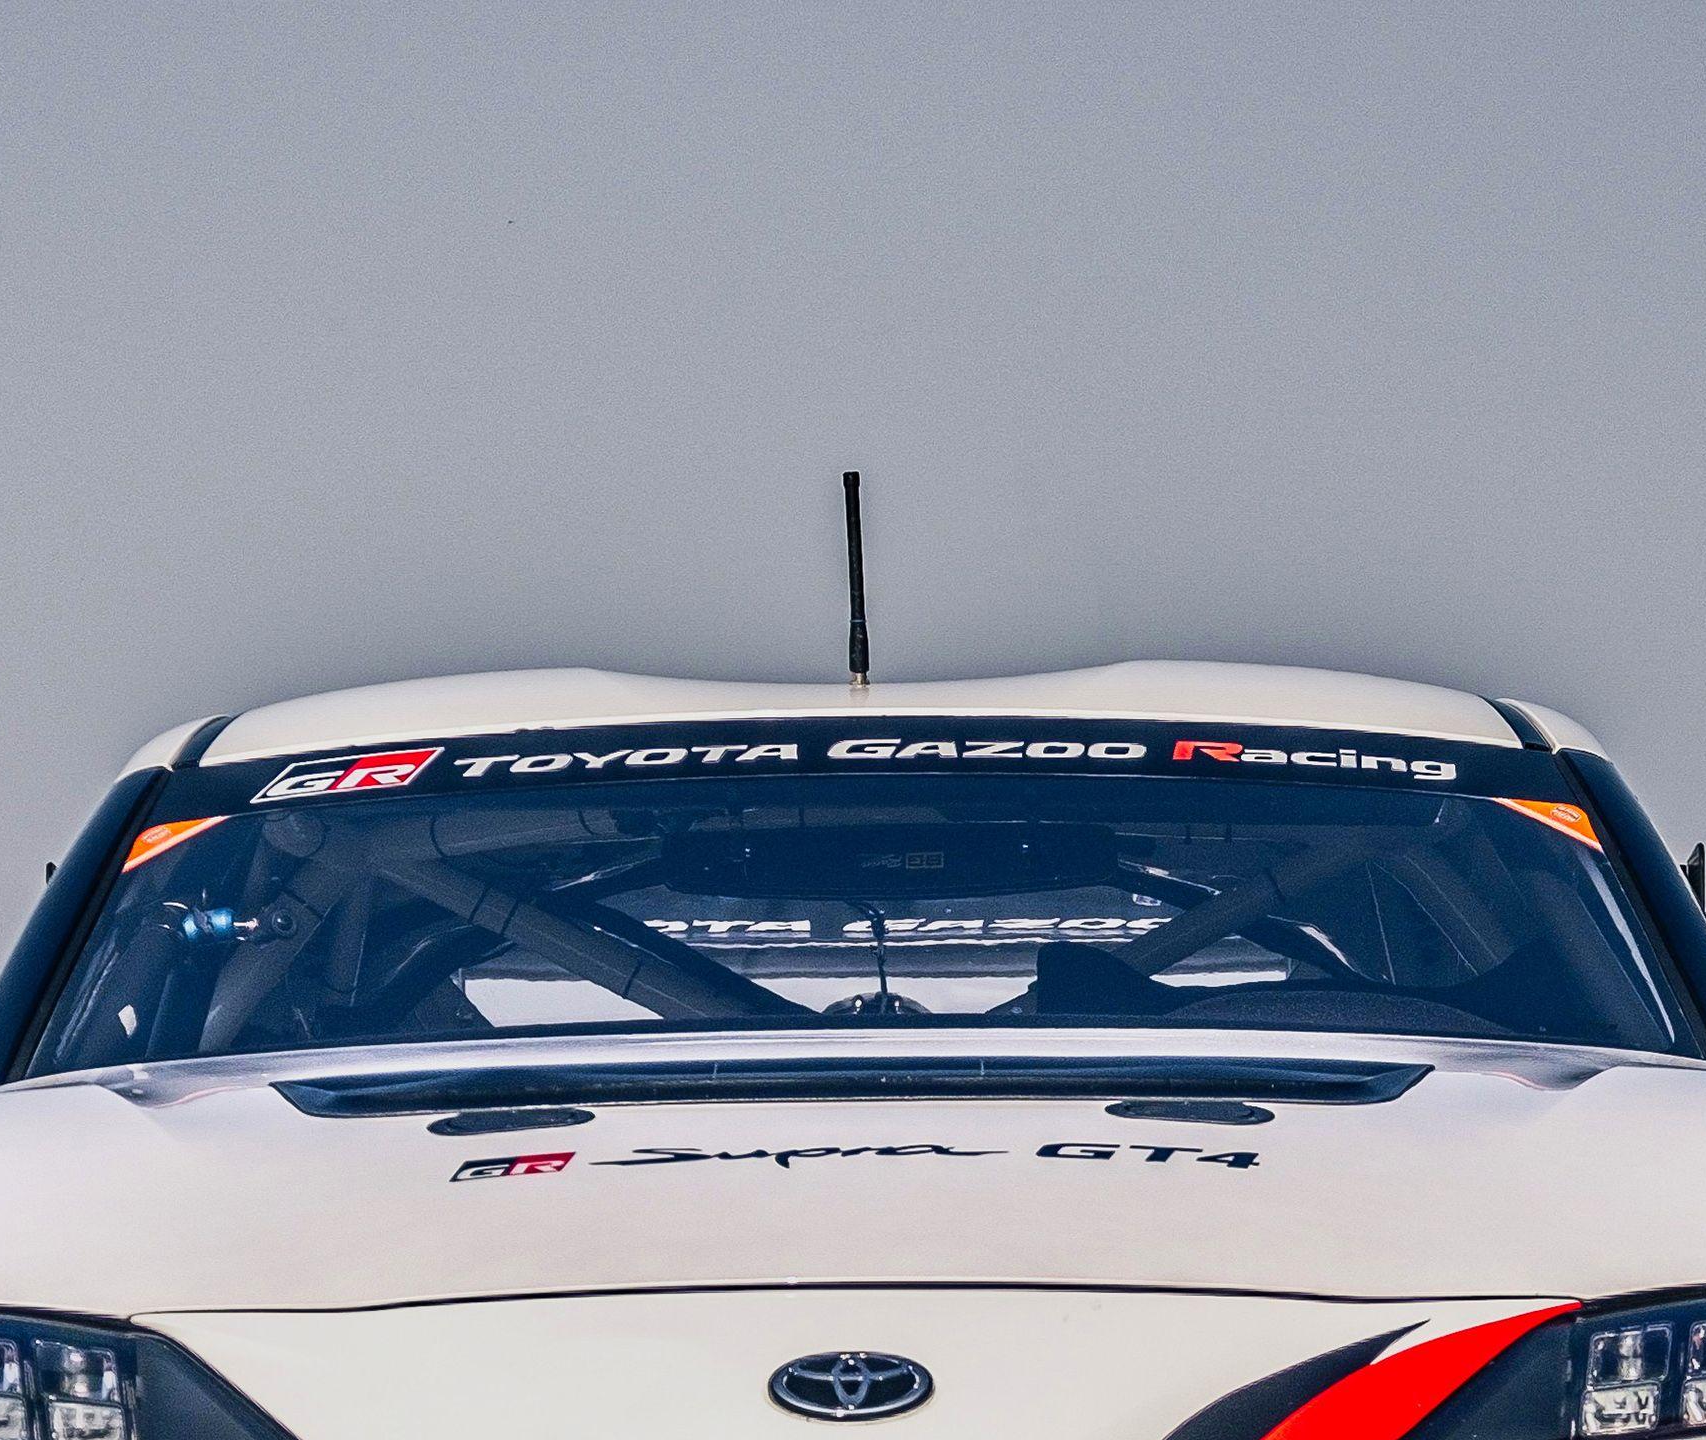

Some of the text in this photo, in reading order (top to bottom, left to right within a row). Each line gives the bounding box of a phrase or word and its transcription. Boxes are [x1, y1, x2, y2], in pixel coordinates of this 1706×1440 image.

[259, 738, 1457, 799] GR TOYOTA GAZOO Racing
[454, 1142, 1260, 1181] GR Supra GT4
